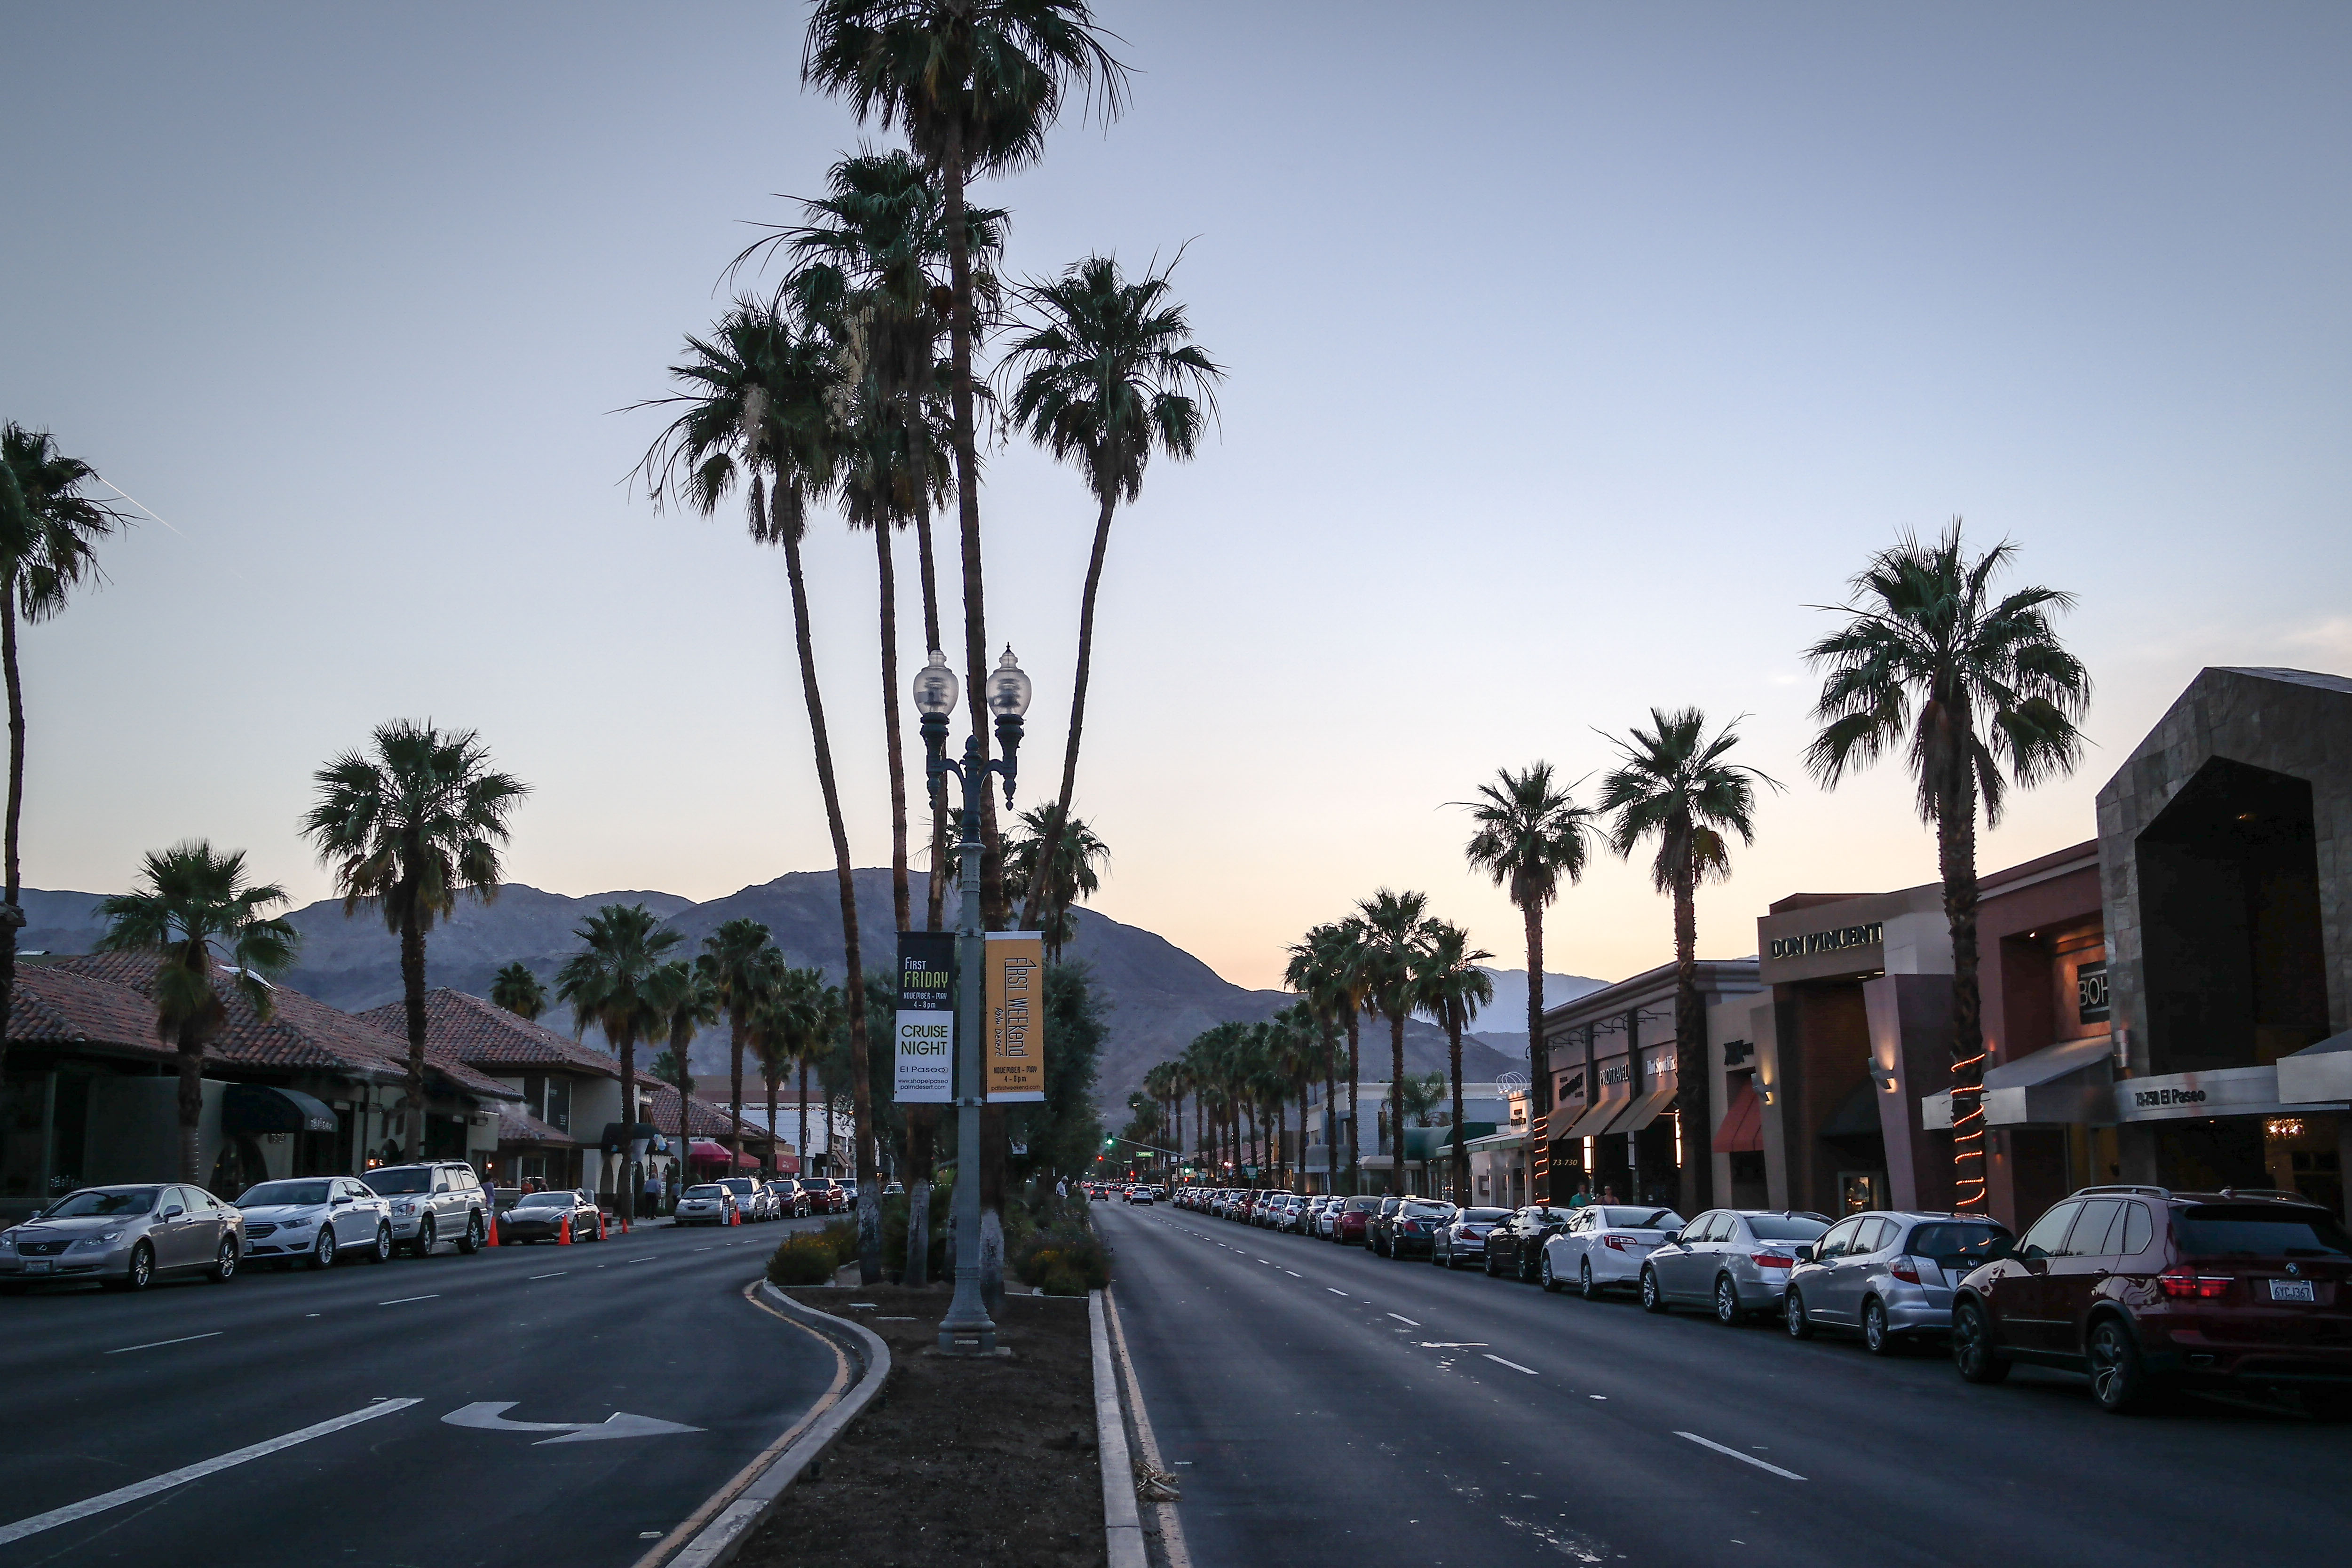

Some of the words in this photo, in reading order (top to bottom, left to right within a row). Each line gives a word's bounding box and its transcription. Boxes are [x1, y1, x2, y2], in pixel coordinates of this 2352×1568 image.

[1771, 936, 1806, 958] DON
[1808, 921, 1883, 953] VINCENT
[905, 957, 926, 970] FIRST
[904, 971, 948, 988] FRIDAY
[995, 1007, 1005, 1026] Palm
[901, 1025, 948, 1037] CRUISE
[901, 1041, 947, 1055] NIGHT
[995, 1029, 1005, 1057] Desert
[1600, 1064, 1628, 1086] PROTRAVEL
[2171, 1089, 2206, 1104] Paseo
